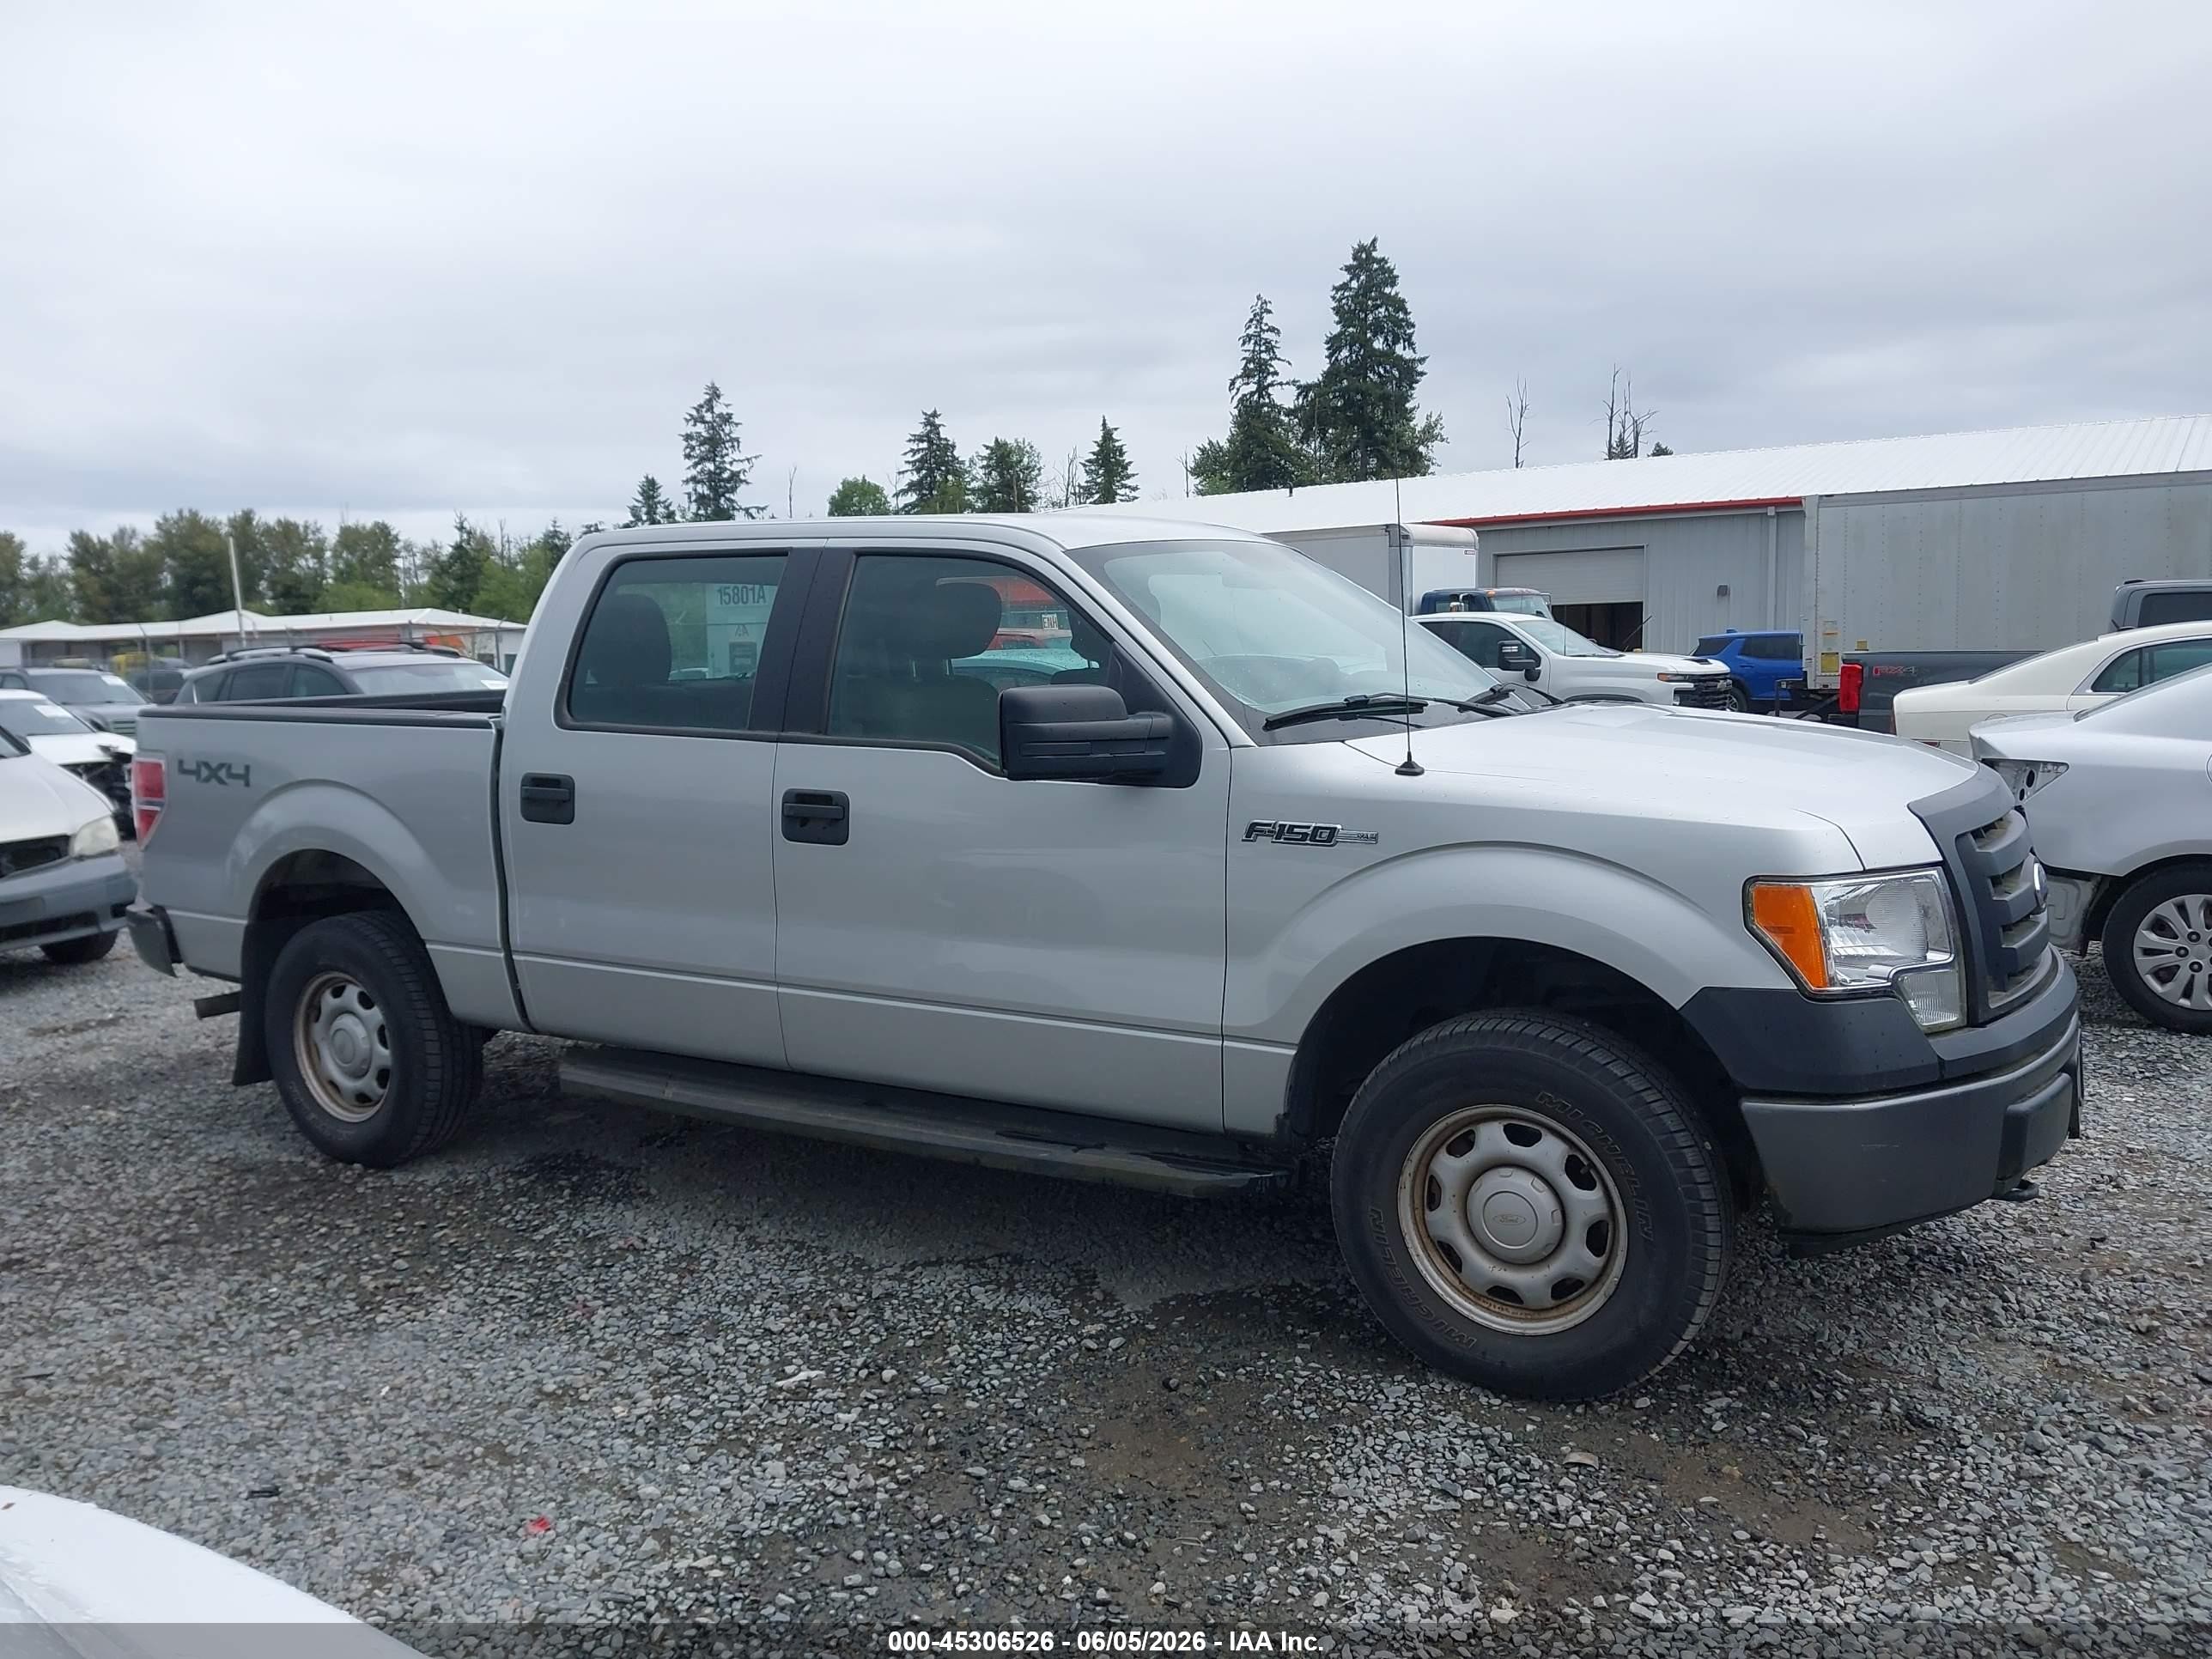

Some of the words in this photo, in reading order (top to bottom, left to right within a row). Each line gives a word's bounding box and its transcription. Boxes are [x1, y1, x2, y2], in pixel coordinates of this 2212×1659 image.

[716, 585, 767, 605] 15801A
[1242, 820, 1341, 847] F-150
[1535, 1091, 1654, 1243] MICHELIN
[1368, 1206, 1477, 1347] MICHELIN
